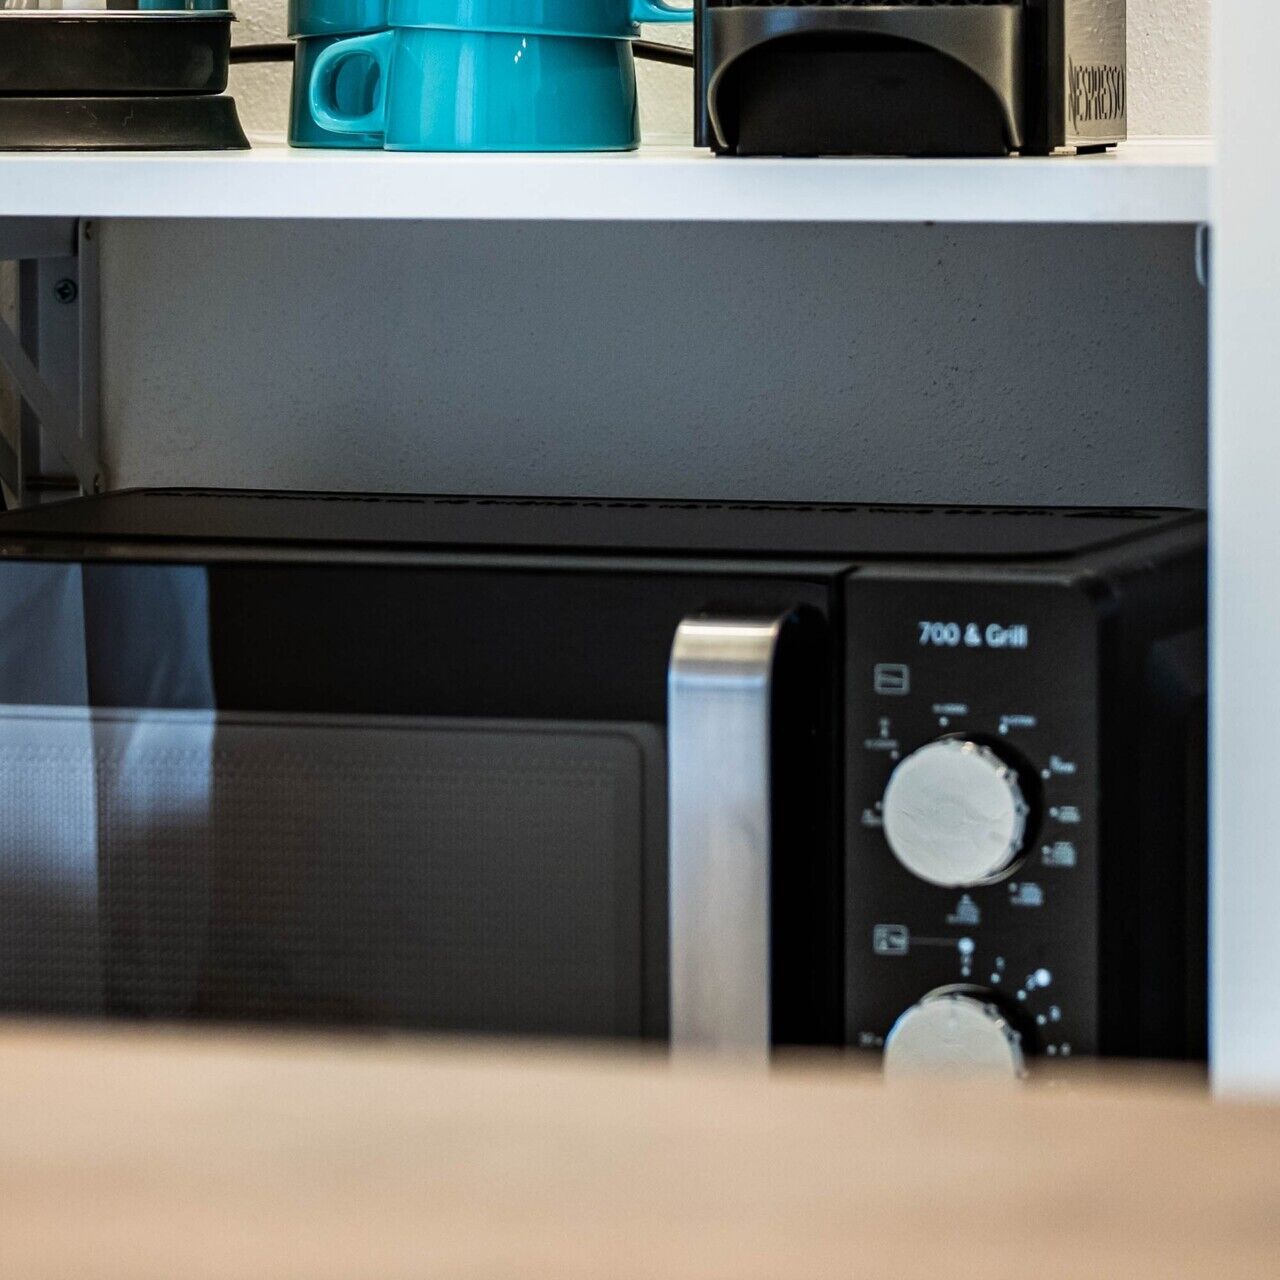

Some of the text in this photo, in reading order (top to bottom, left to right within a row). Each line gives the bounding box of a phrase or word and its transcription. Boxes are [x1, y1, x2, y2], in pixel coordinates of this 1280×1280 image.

[918, 621, 1028, 648] 700 & Grill
